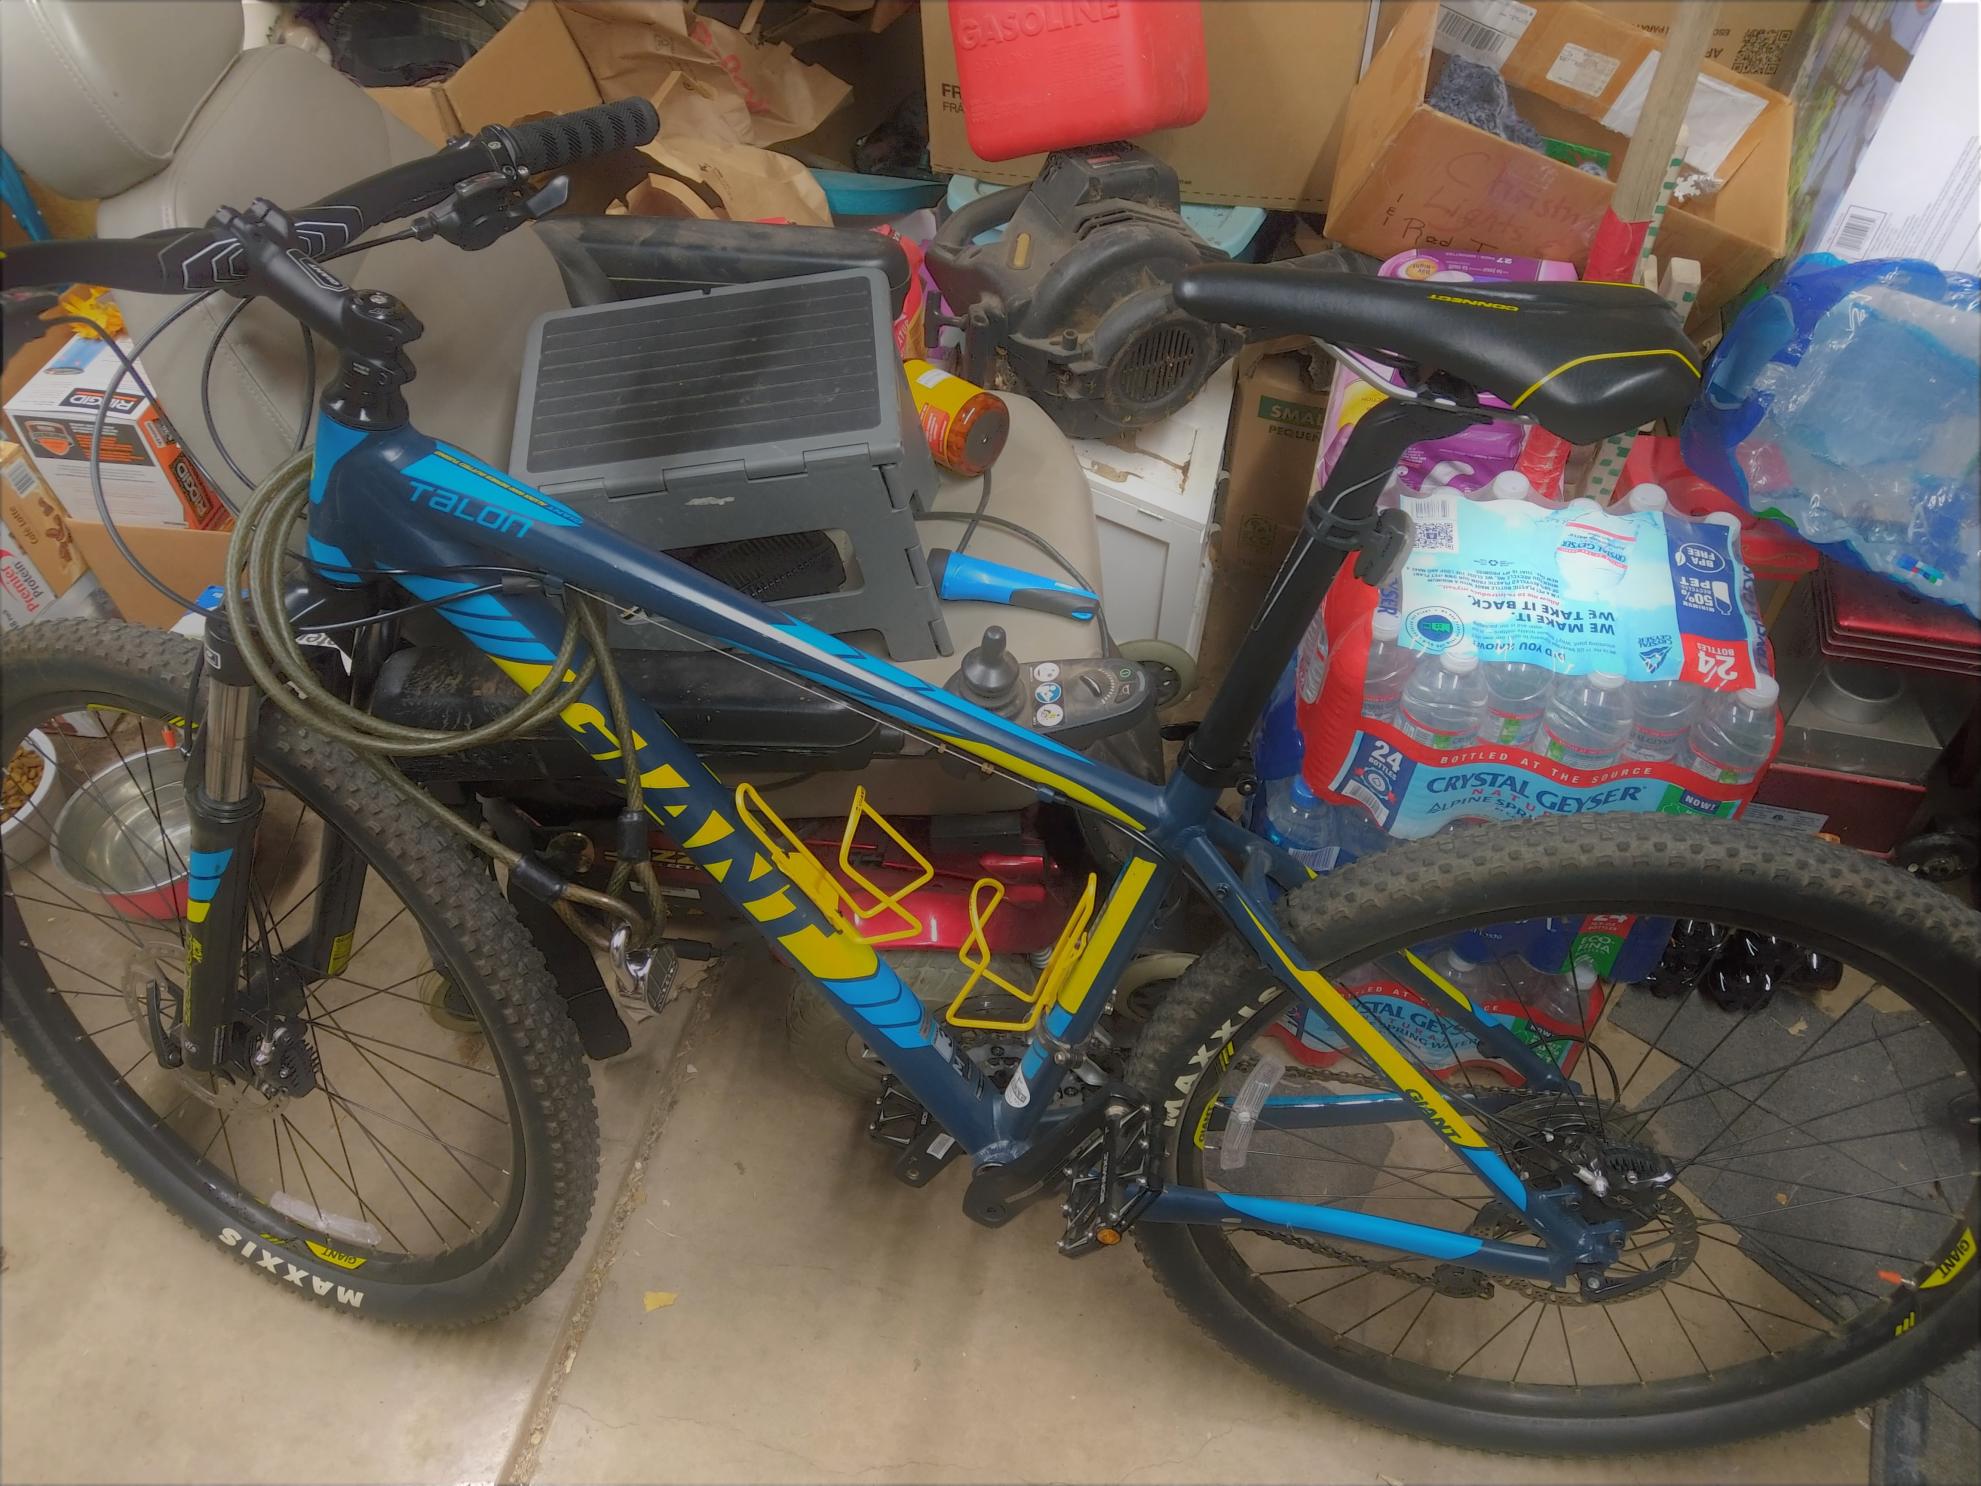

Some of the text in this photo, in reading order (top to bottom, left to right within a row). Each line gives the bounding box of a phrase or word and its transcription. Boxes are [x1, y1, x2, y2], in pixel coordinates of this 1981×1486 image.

[957, 0, 1121, 50] GASOLINE
[1427, 294, 1519, 312] CONNECT
[1687, 546, 1716, 560] FREE
[1691, 555, 1715, 568] BPA
[1, 564, 40, 613] Premier
[14, 561, 44, 599] Protein
[1680, 577, 1711, 589] PET
[1467, 594, 1615, 622] WE TAKE IT BACK.
[1680, 589, 1714, 607] 50%
[1682, 601, 1715, 612] MINIMUM
[1511, 612, 1615, 636] WE MAKE IT.
[1518, 642, 1542, 652] YOU
[1697, 643, 1735, 656] BOTTLES
[1697, 651, 1738, 681] 24
[1370, 740, 1403, 772] 24
[1440, 752, 1653, 784] BOTTLED AT THE SOURCE
[1368, 756, 1397, 781] BOTTLES
[1426, 772, 1641, 814] CRYSTAL GEYSER
[1684, 794, 1717, 812] NOW!
[1426, 796, 1495, 815] ALPINE
[1392, 988, 1409, 998] AT
[1163, 986, 1286, 1127] MAXXIS
[1405, 1088, 1462, 1139] GIANT
[218, 1227, 364, 1308] MAXXIS
[321, 1248, 357, 1265] GIANT
[1938, 1239, 1970, 1279] GIANT
